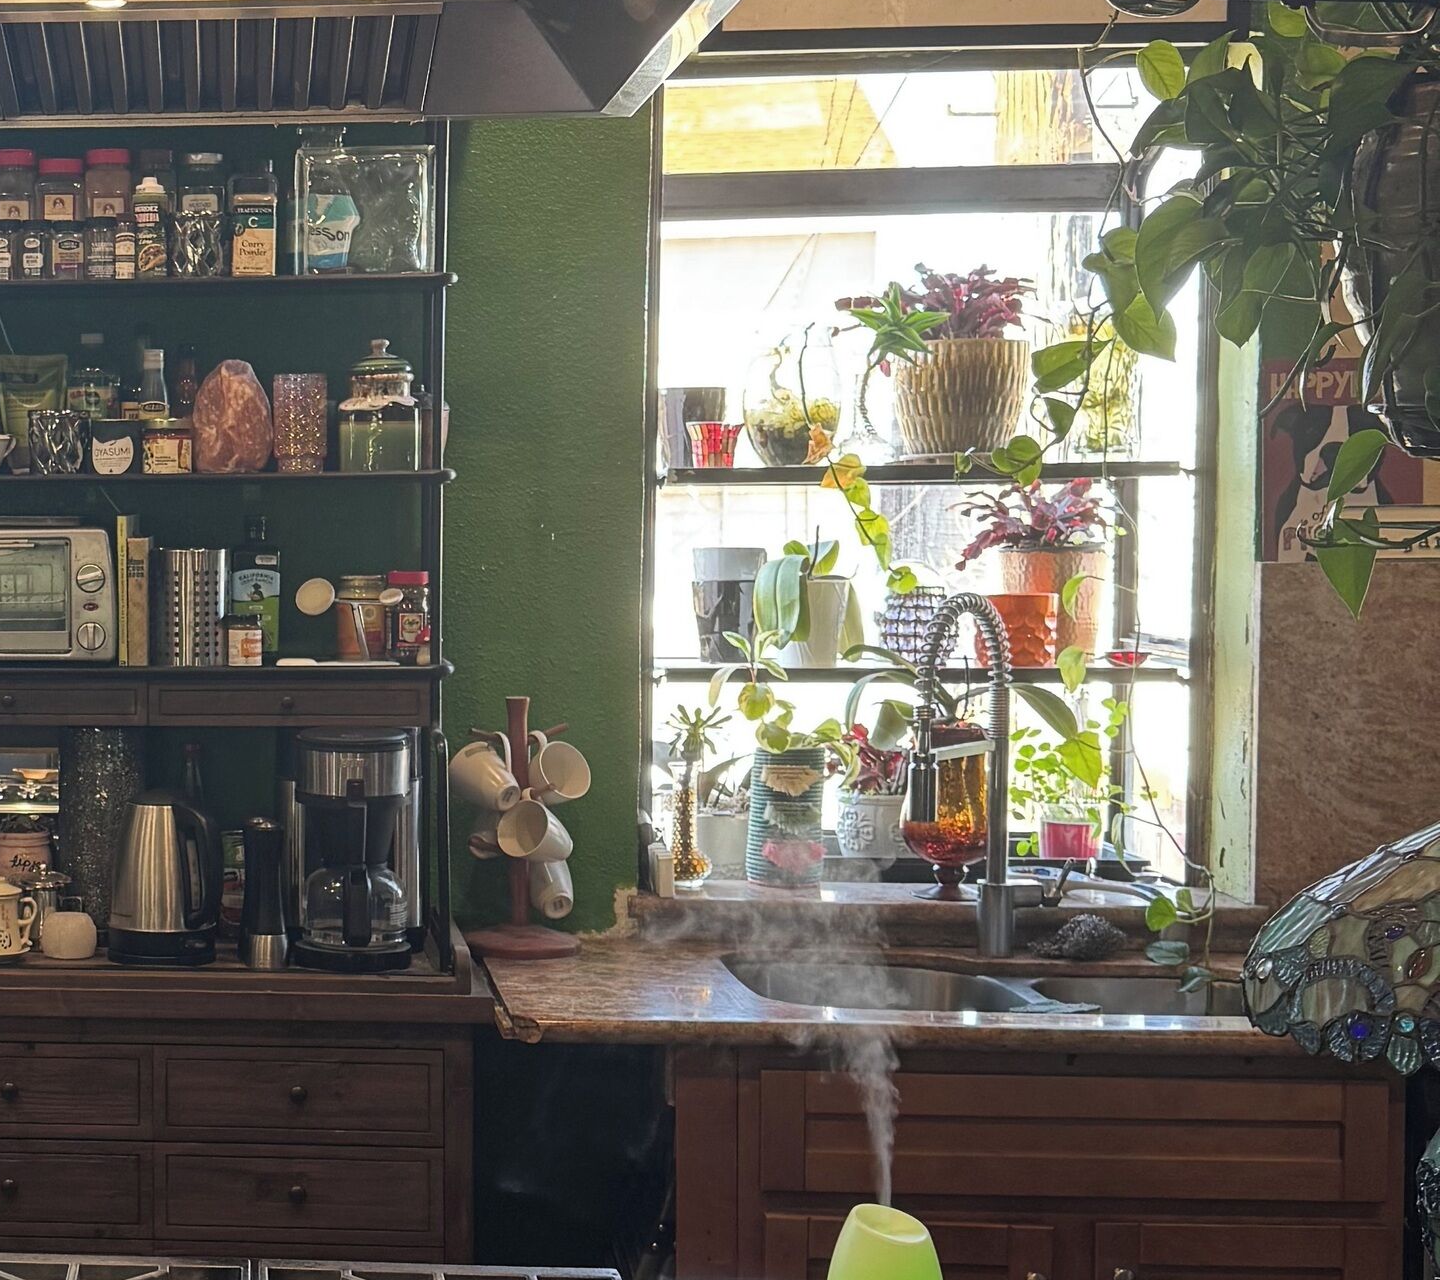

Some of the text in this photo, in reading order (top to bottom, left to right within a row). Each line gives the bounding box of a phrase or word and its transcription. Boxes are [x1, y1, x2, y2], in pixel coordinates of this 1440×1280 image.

[248, 216, 259, 228] C
[308, 224, 350, 242] esson
[241, 239, 265, 249] Curry
[239, 248, 267, 257] Powder
